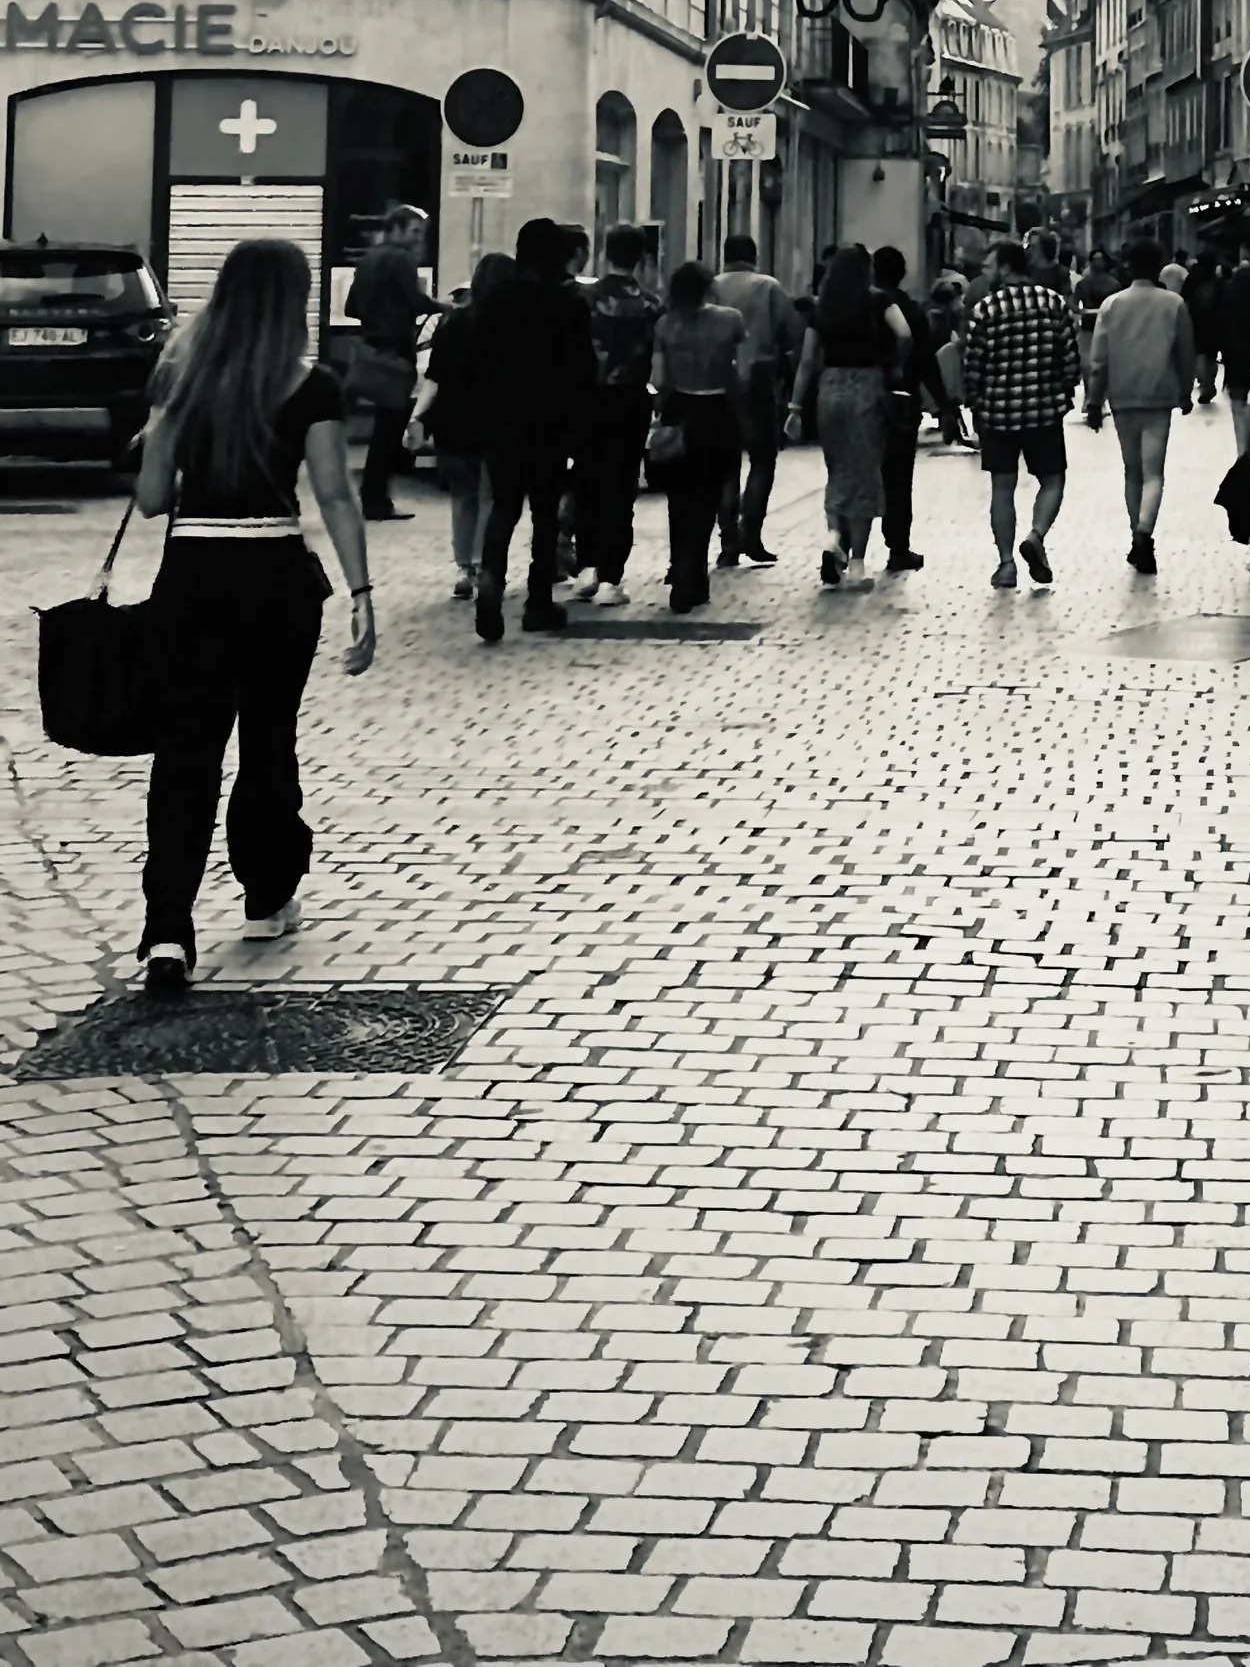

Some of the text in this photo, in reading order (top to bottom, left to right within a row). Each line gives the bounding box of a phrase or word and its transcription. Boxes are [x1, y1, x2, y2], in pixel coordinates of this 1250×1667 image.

[5, 1, 358, 56] MACIE DANJOU
[727, 116, 762, 128] SAUF
[453, 153, 489, 166] SAUF
